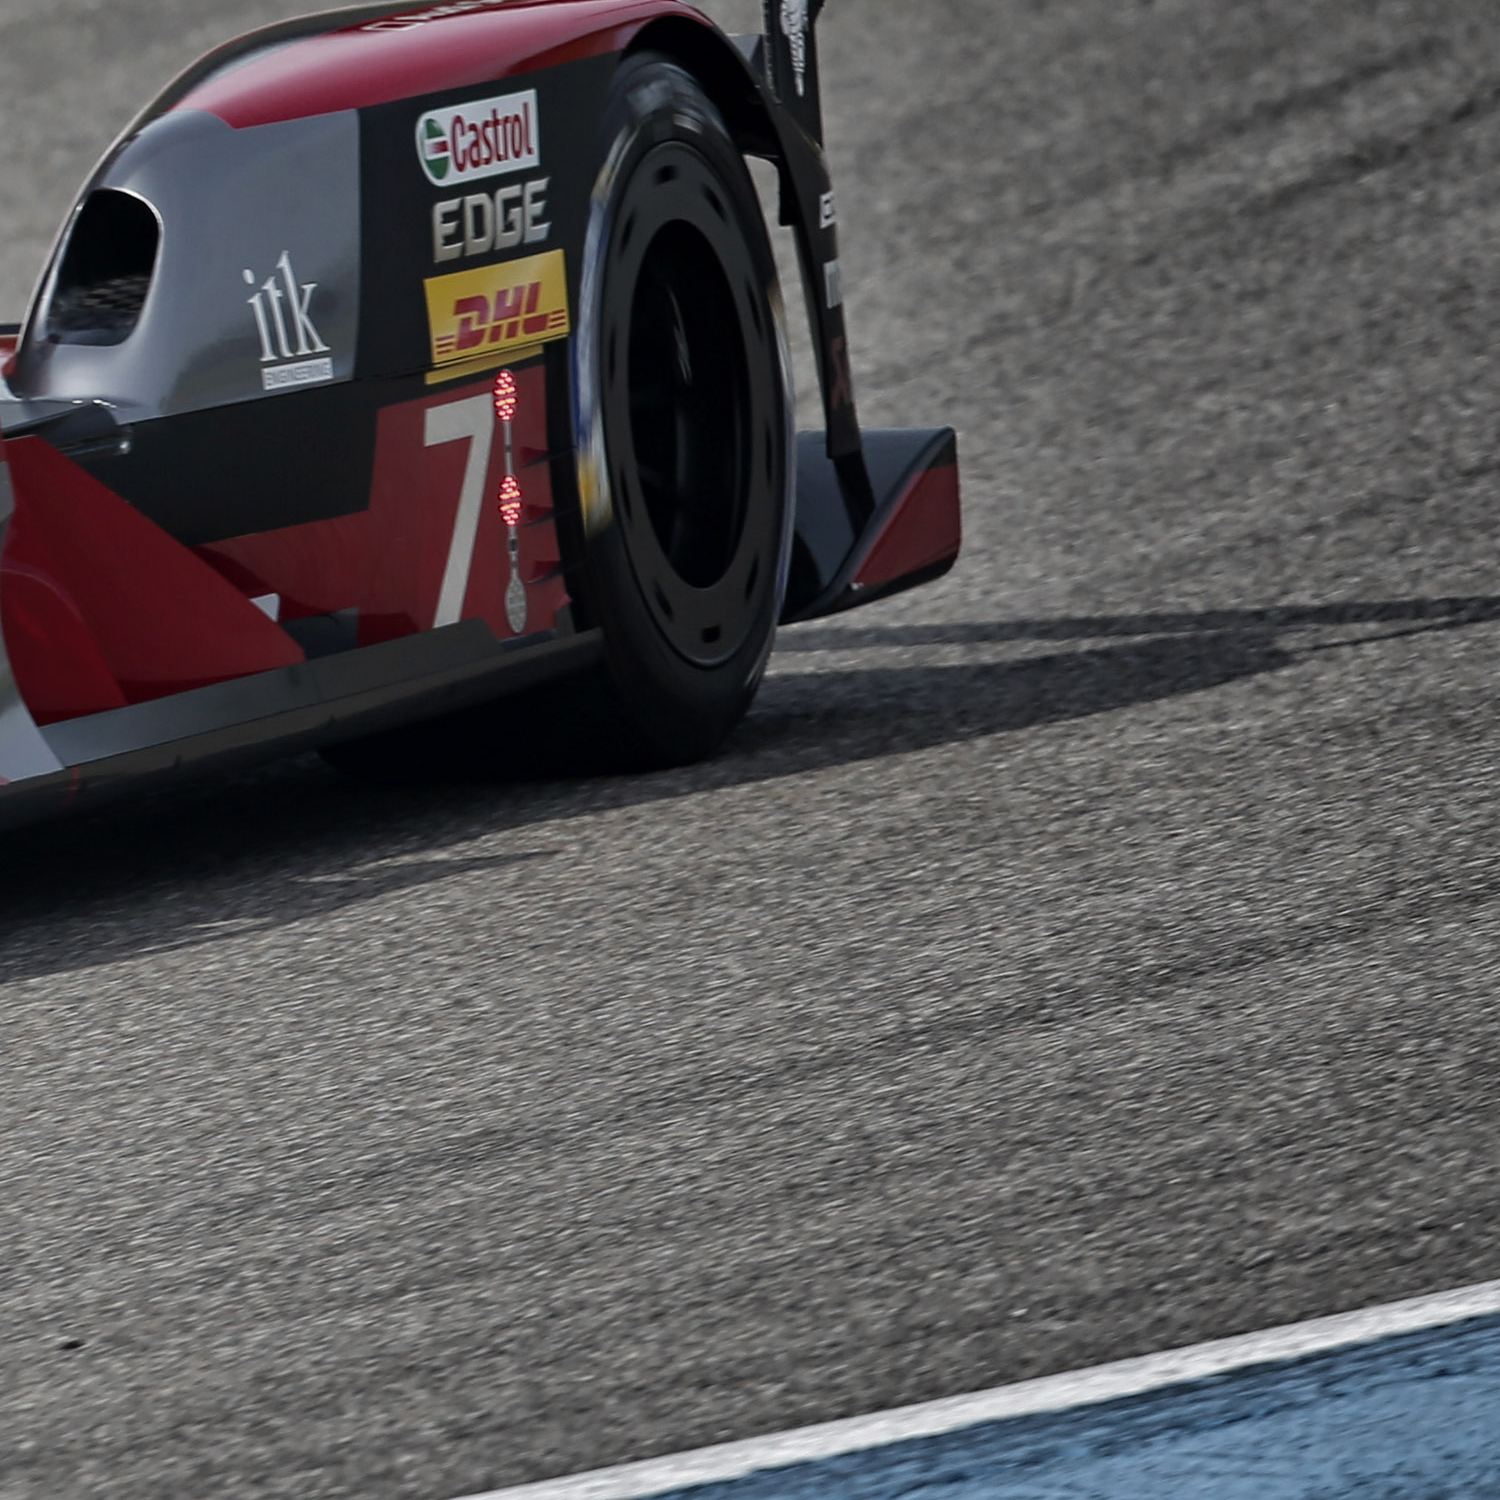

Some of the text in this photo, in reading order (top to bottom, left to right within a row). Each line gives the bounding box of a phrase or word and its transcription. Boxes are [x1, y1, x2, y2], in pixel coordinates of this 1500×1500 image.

[452, 102, 534, 173] Castrol
[432, 177, 552, 263] EDGE
[242, 250, 331, 361] itk
[452, 281, 552, 350] DHL
[424, 391, 495, 629] 7
